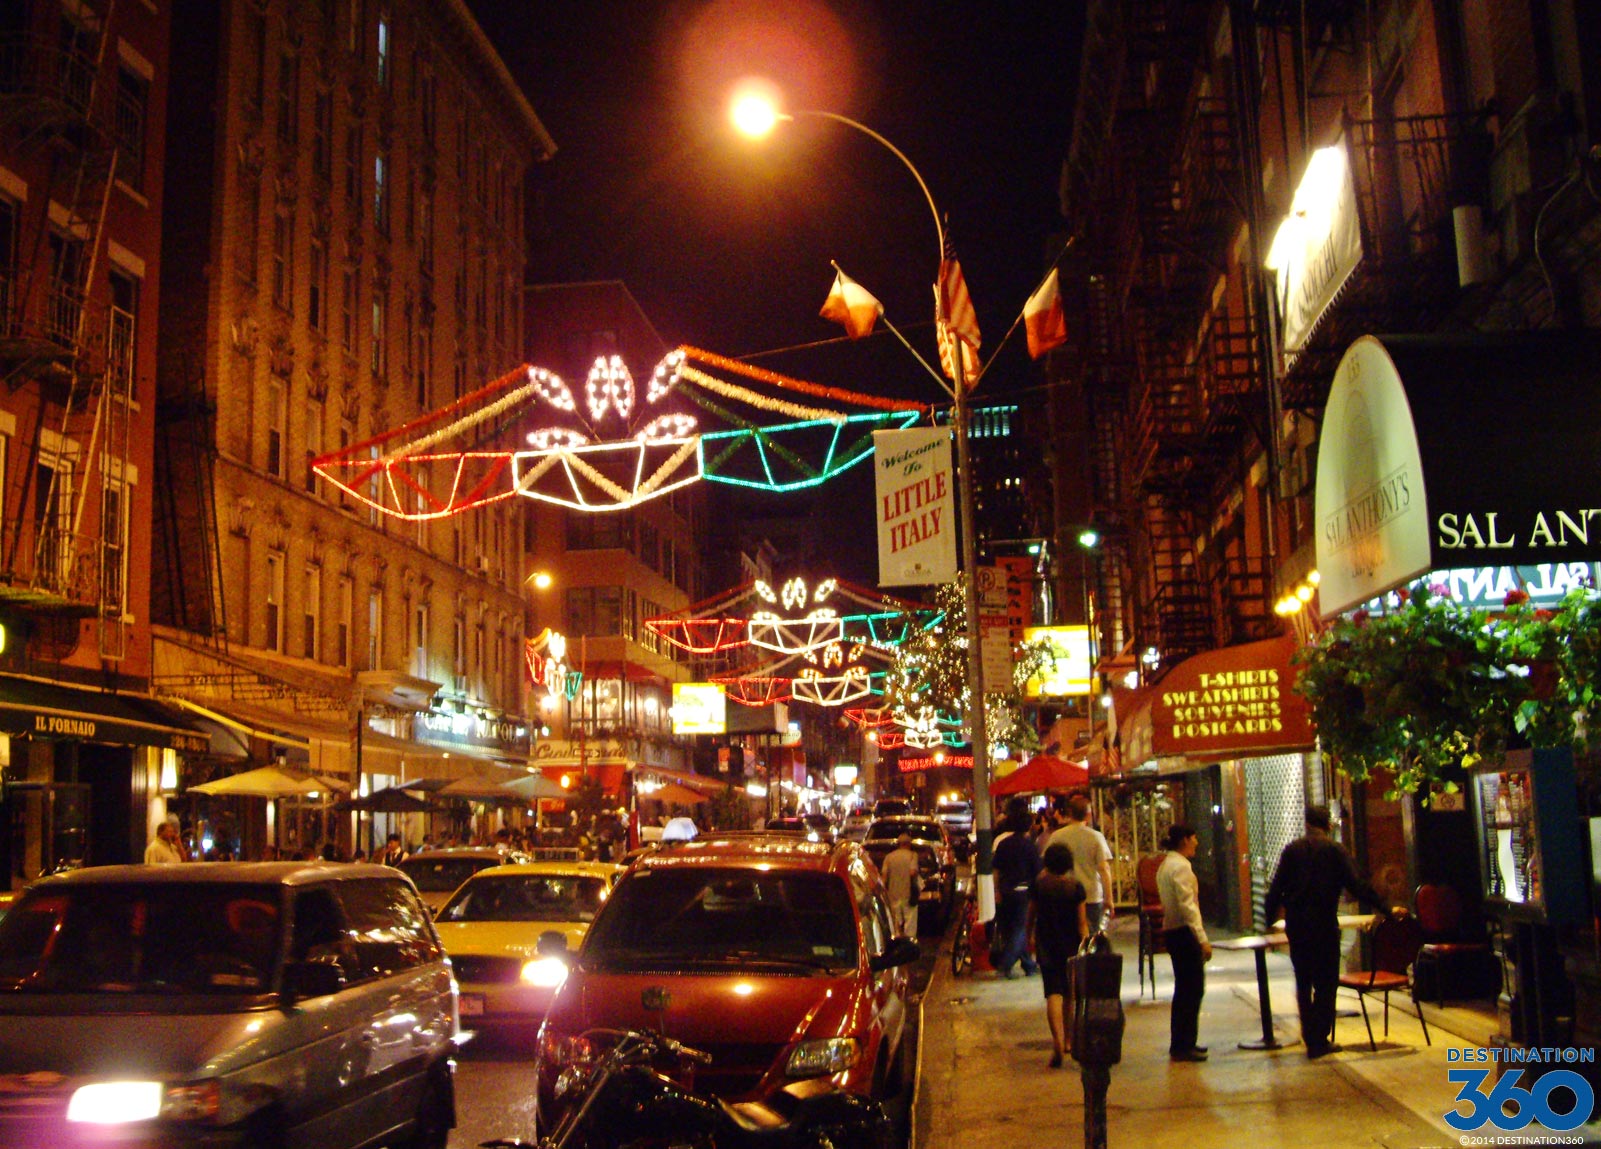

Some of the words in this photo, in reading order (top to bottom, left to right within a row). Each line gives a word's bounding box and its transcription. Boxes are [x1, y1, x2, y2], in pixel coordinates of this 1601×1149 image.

[881, 436, 944, 469] Welcome
[903, 461, 924, 477] To
[883, 470, 947, 522] LITTLE
[1325, 515, 1347, 551] SAL
[1346, 470, 1411, 541] ANTHONY'S
[890, 506, 942, 554] ITALY
[1438, 512, 1515, 548] SAL
[1198, 668, 1279, 688] T-SHIRTS
[1162, 685, 1280, 707] SWEATSHIRTS
[1174, 701, 1281, 722] SOUVENIRS
[35, 715, 47, 732] IL
[48, 716, 96, 737] FORNAIO
[1173, 717, 1283, 739] POSTCARDS
